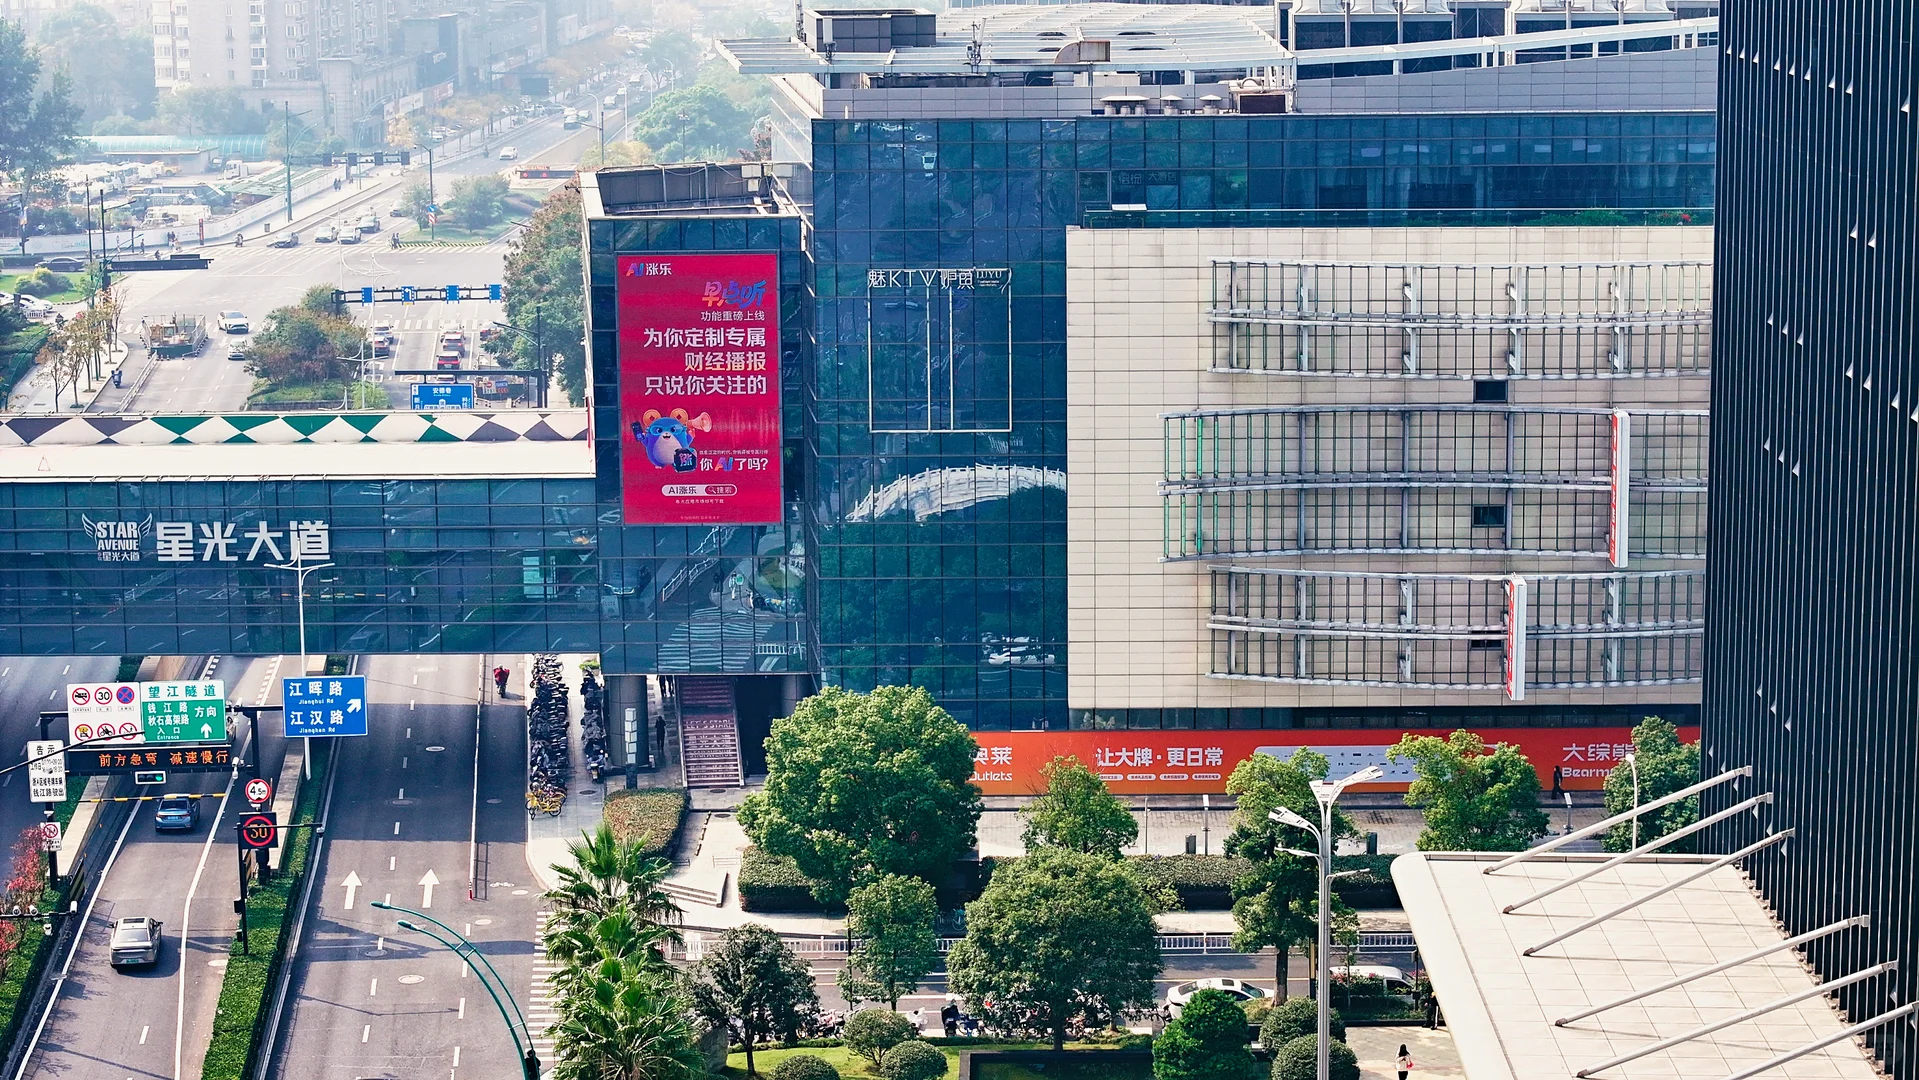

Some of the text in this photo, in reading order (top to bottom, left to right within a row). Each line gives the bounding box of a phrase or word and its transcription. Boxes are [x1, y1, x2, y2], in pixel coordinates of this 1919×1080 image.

[701, 310, 765, 322] 功能重磅上线
[643, 327, 766, 348] 为你定制专属
[684, 351, 767, 372] 财经播报
[644, 375, 767, 396] 只说你关注的
[668, 485, 697, 495] AI涨乐
[97, 522, 138, 539] STAR
[97, 539, 140, 551] AVENUE
[156, 520, 331, 562] 星光大道
[148, 684, 217, 699] 望江隧道
[289, 680, 343, 697] 江晖路
[98, 691, 110, 701] 30
[147, 701, 189, 713] 钱江路
[194, 705, 217, 718] 方向
[147, 713, 190, 726] 秋石高架路
[290, 709, 344, 726] 江汉路
[157, 726, 180, 735] 入口
[327, 725, 336, 734] Rd
[36, 744, 55, 756] 告示
[1095, 746, 1224, 767] 让大牌·更日常
[98, 749, 229, 768] 前方急弯 减速慢行
[1561, 767, 1613, 778] Bearm
